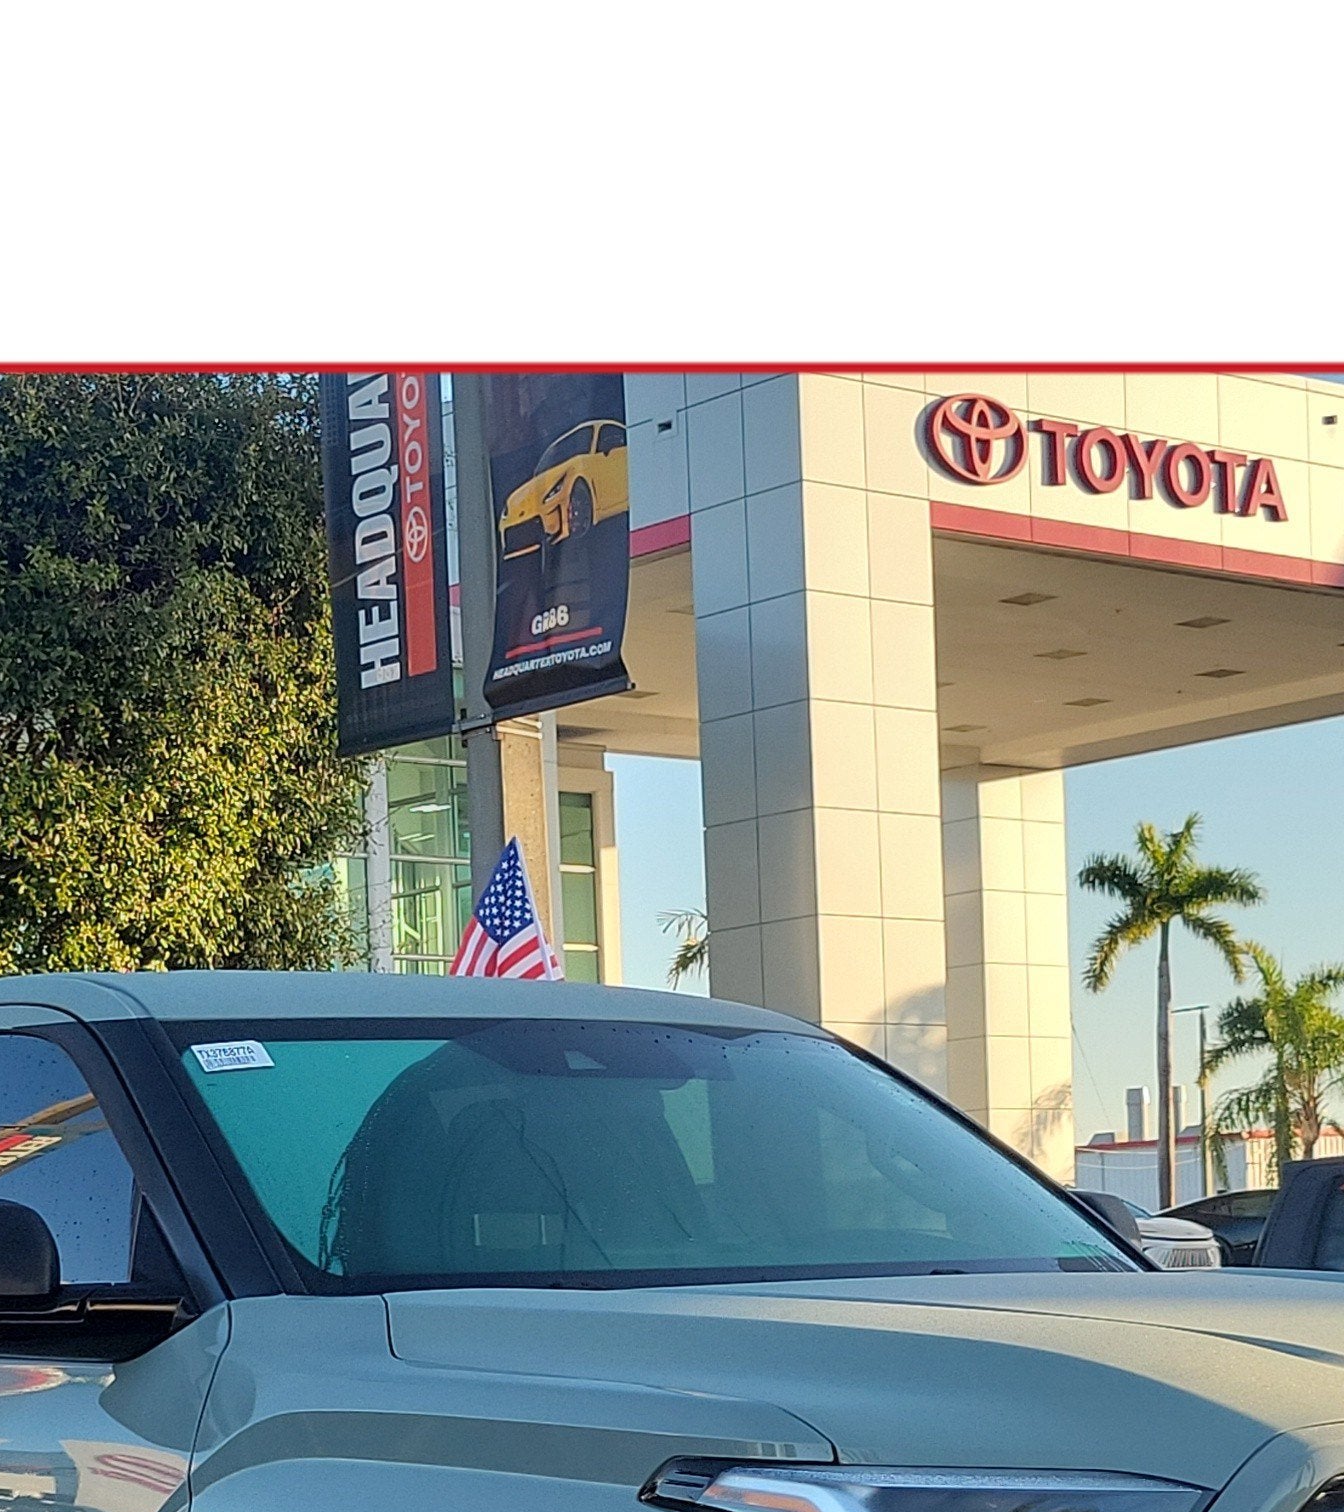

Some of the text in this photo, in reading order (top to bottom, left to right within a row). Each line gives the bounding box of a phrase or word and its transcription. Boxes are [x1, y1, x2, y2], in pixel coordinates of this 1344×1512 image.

[402, 373, 424, 503] TOYO
[1028, 418, 1289, 522] TOYOTA
[346, 373, 400, 689] HEADQUA
